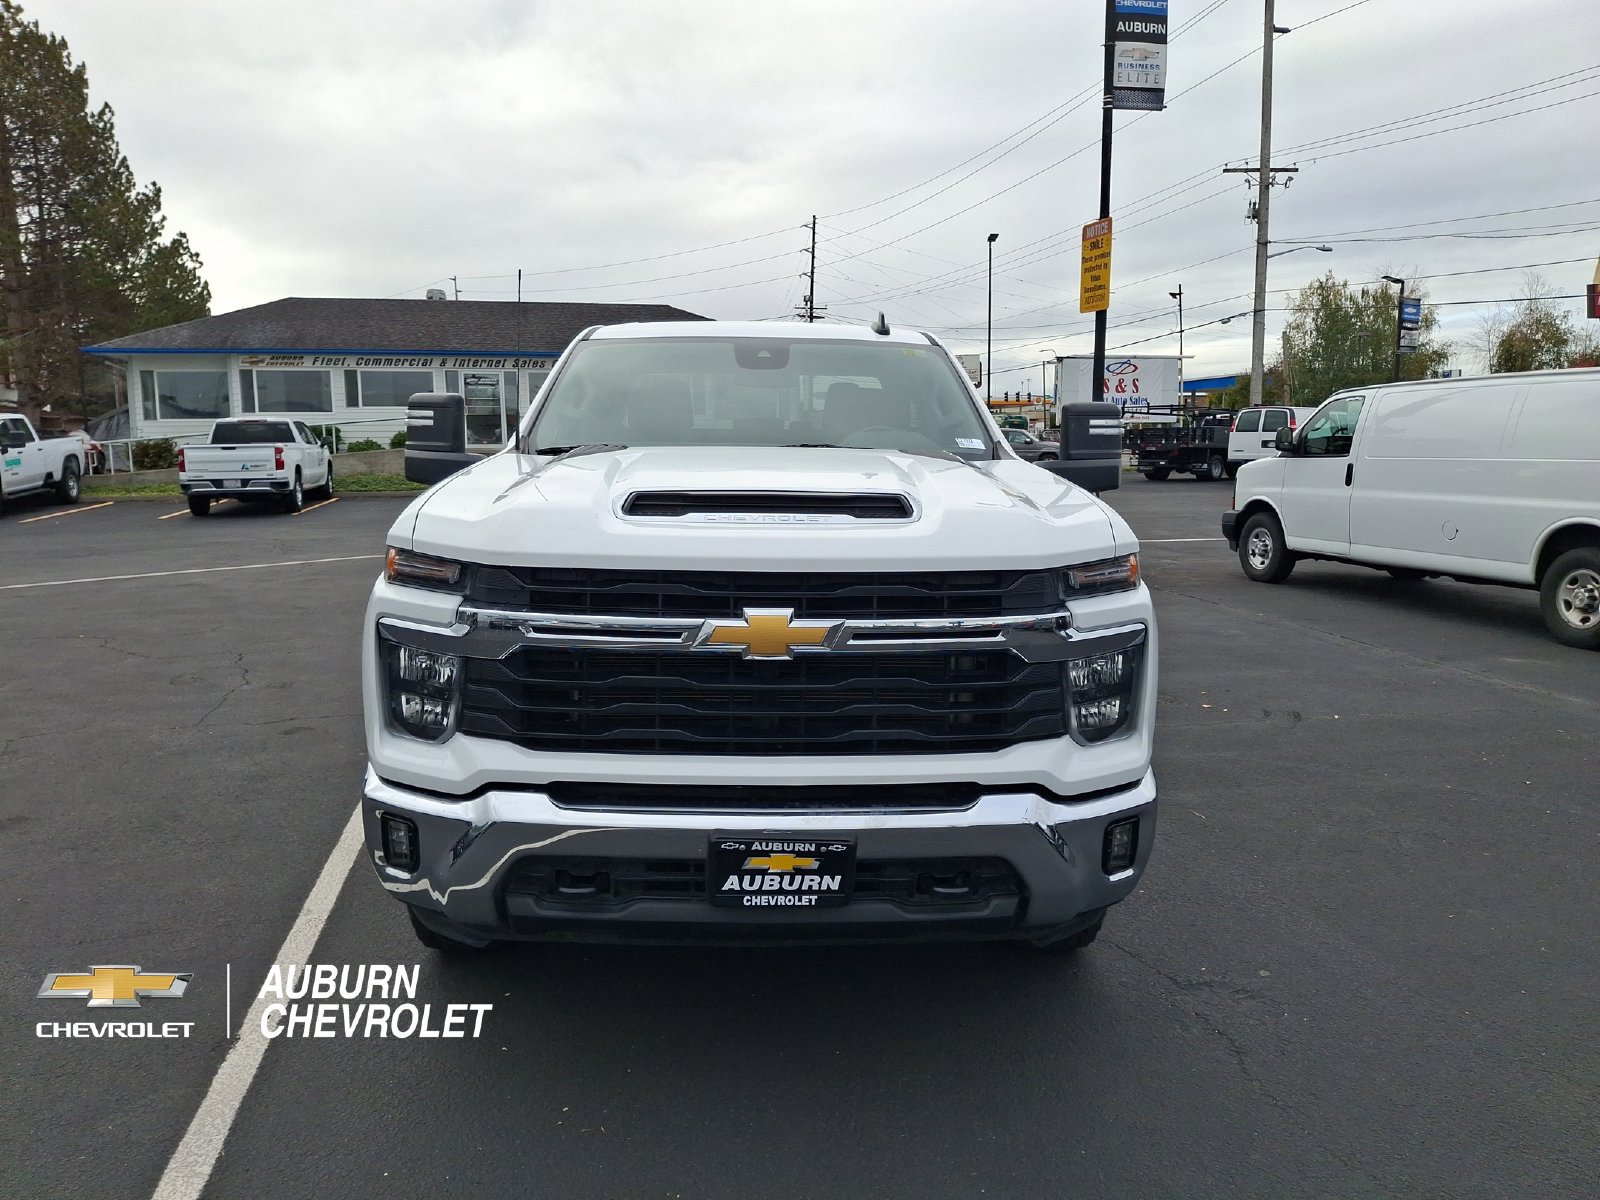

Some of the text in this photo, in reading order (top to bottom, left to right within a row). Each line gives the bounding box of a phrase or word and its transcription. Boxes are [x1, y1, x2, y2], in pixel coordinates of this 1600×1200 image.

[1115, 0, 1168, 9] CHEVROLET
[1116, 21, 1166, 34] AUBURN
[1117, 62, 1160, 71] BUSINESS
[1117, 72, 1160, 84] ELITE
[1087, 222, 1109, 238] NOTICE
[1090, 239, 1104, 251] SMILE
[355, 357, 434, 367] Commercial
[440, 357, 448, 367] &
[453, 357, 507, 368] Internet
[512, 358, 547, 369] Sales
[1103, 378, 1139, 393] S & S
[1111, 396, 1128, 405] Auto
[1129, 396, 1148, 406] Sales
[703, 514, 833, 522] CHEVROLET
[751, 841, 816, 852] AUBURN
[721, 875, 842, 891] AUBURN
[743, 895, 818, 906] CHEVROLET
